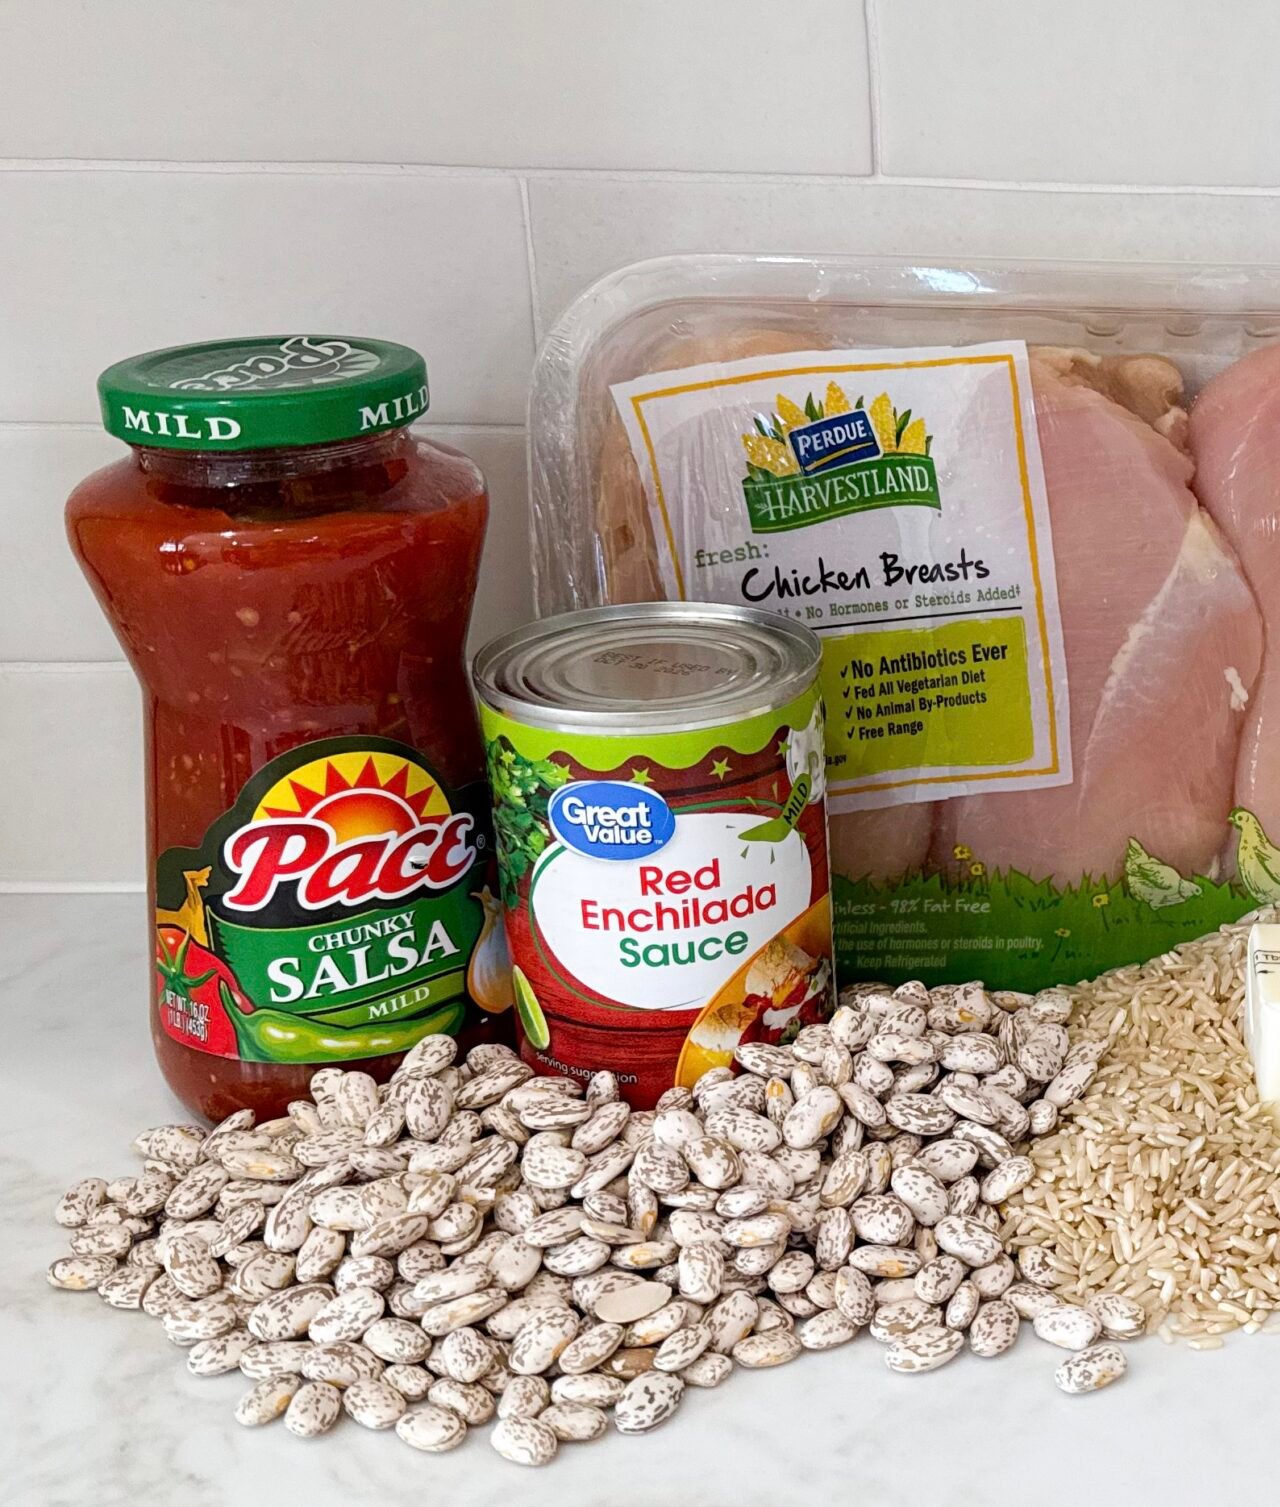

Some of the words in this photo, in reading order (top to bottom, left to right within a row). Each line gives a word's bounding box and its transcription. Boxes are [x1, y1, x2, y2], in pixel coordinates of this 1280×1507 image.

[121, 406, 242, 441] MILD
[358, 385, 429, 430] MILD
[797, 420, 867, 456] PERDUE
[765, 467, 930, 521] HARVESTLAND
[694, 542, 771, 569] fresh:
[742, 557, 870, 602] Chicken
[880, 547, 990, 587] Breasts
[806, 606, 823, 620] No
[829, 599, 889, 617] Hormones
[895, 598, 909, 610] or
[915, 591, 971, 608] Steroids
[852, 660, 874, 679] No
[879, 648, 967, 676] Antibiotics
[971, 643, 1008, 663] Ever
[854, 685, 875, 700] Fed
[879, 681, 894, 697] All
[897, 674, 958, 695] Vegetarian
[961, 669, 986, 685] Diet
[856, 706, 872, 720] No
[876, 701, 915, 717] Animal
[919, 691, 987, 712] By-Products
[859, 725, 884, 740] Free
[888, 719, 923, 736] Range
[563, 796, 651, 829] Great
[783, 783, 807, 825] MILD
[585, 823, 652, 846] Value
[223, 813, 476, 911] Pace
[640, 858, 720, 896] Red
[582, 882, 777, 933] Enchilada
[890, 898, 920, 914] 98%
[924, 899, 951, 913] Fat
[955, 899, 991, 913] Free
[307, 910, 416, 953] CHUNKY
[619, 930, 749, 968] Sauce
[889, 937, 939, 949] hormones
[940, 939, 951, 949] or
[953, 936, 993, 949] steroids
[995, 936, 1006, 948] in
[1007, 936, 1044, 950] poultry.
[266, 920, 460, 1003] SALSA
[884, 955, 947, 970] Refrigerated
[367, 985, 430, 1020] MILD
